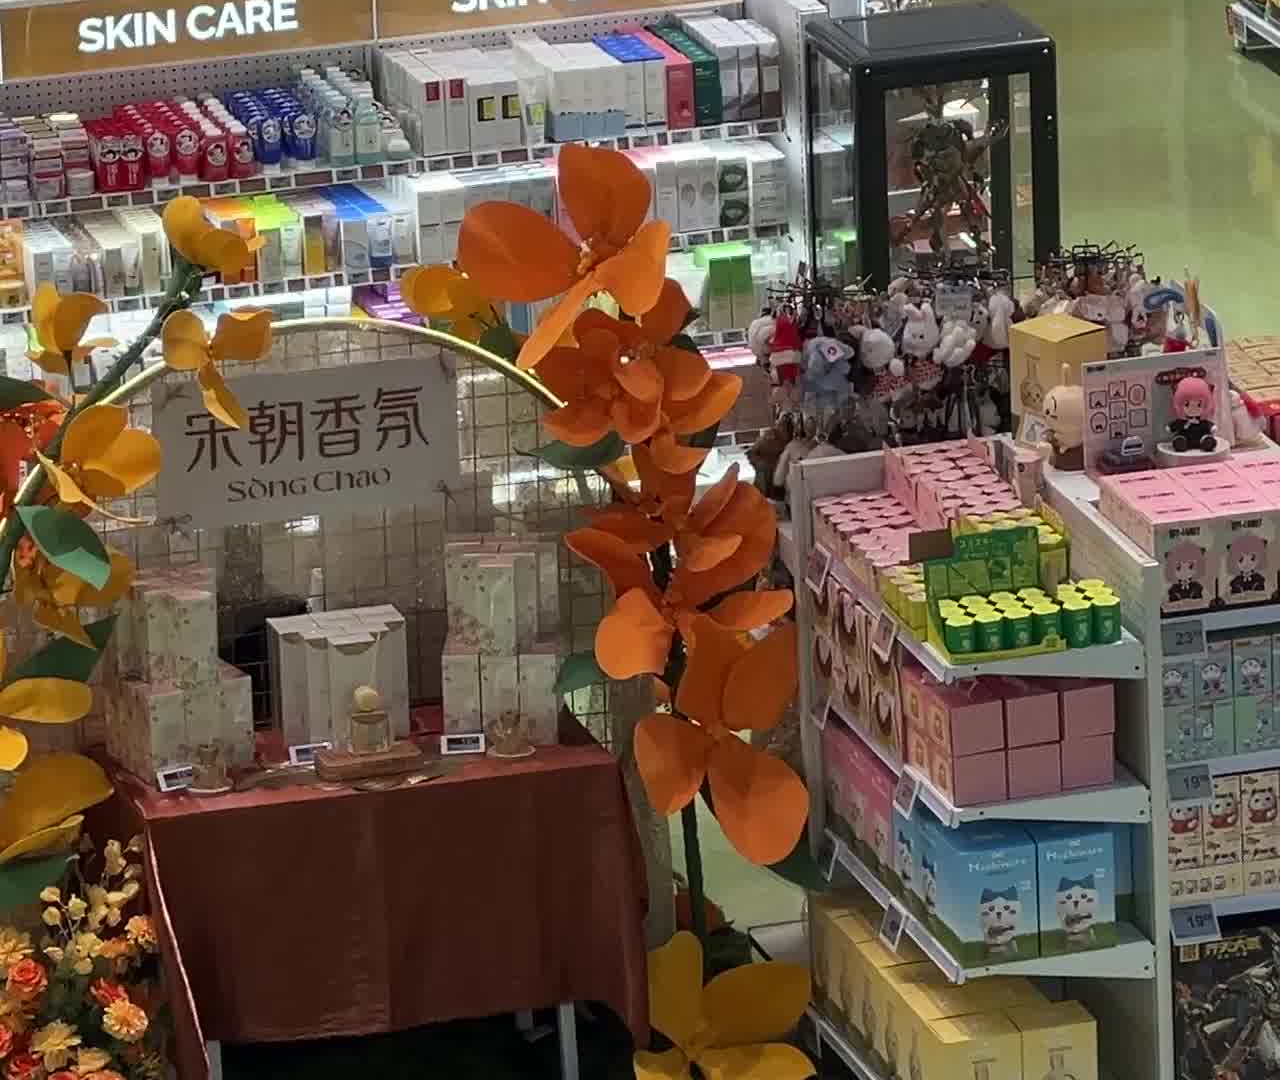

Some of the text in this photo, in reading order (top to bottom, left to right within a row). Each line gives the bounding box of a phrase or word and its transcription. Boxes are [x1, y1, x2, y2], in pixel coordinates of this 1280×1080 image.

[76, 9, 177, 54] SKIN
[185, 385, 430, 474] 宋朝香氛
